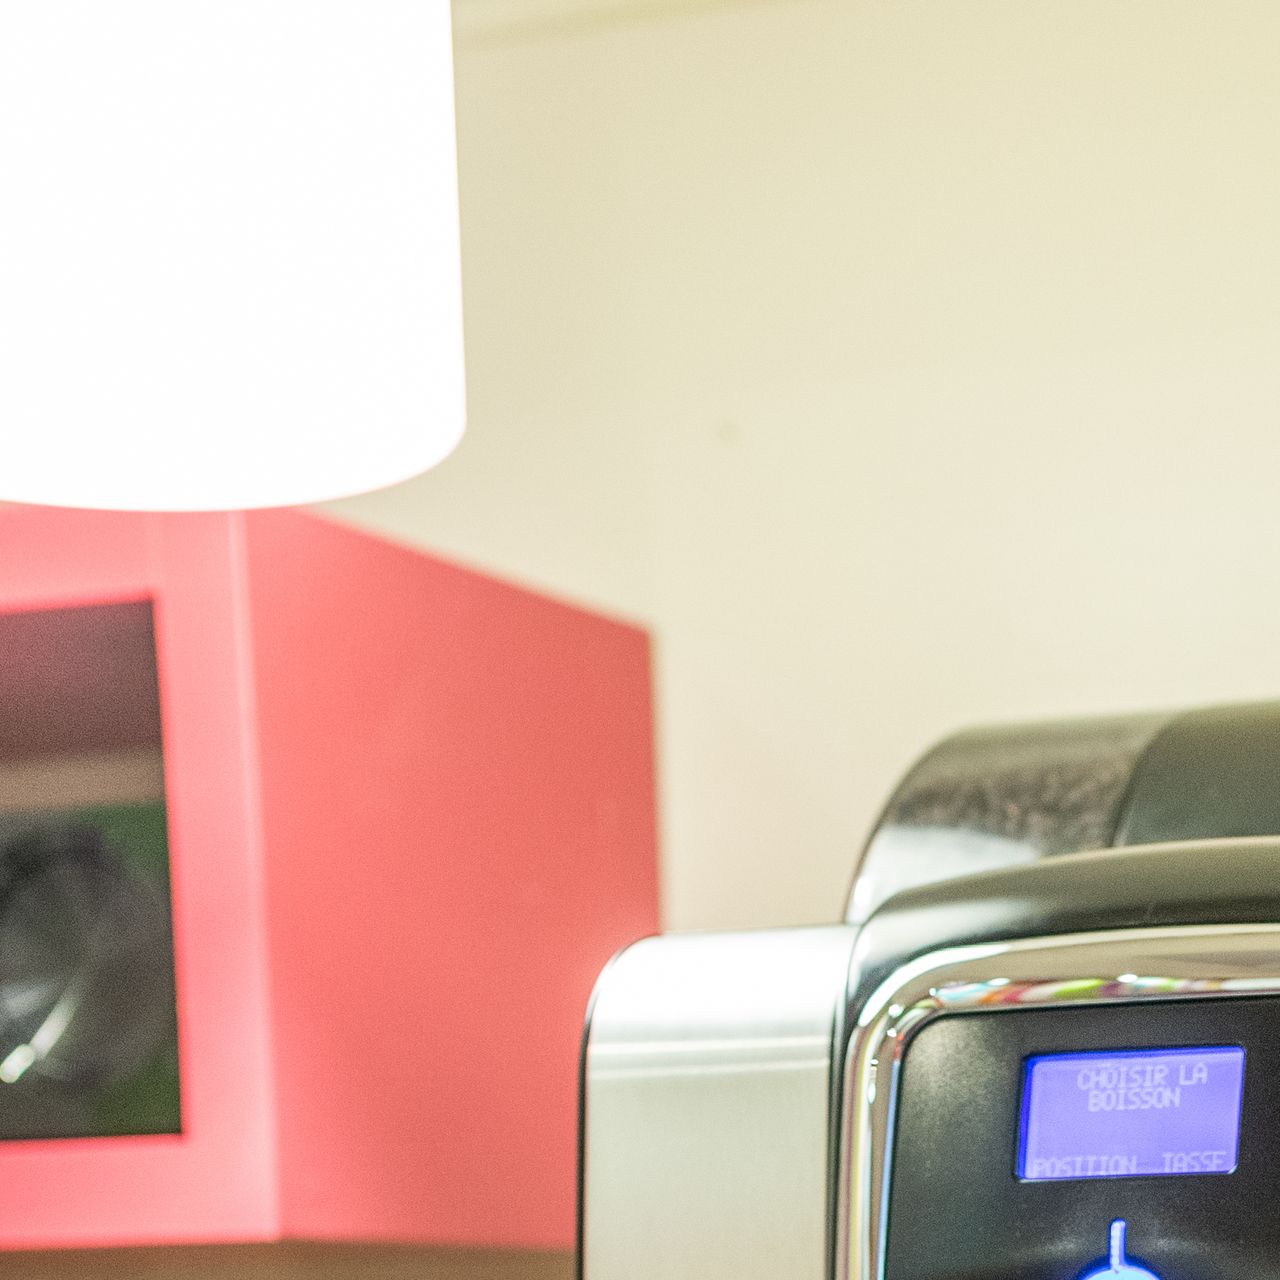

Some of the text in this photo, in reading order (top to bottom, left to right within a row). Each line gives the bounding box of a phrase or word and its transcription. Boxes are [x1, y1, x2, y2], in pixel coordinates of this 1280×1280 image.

[1077, 1062, 1209, 1090] CHOISIR LA
[1087, 1087, 1182, 1112] BOISSON
[1033, 1154, 1137, 1177] POSITION
